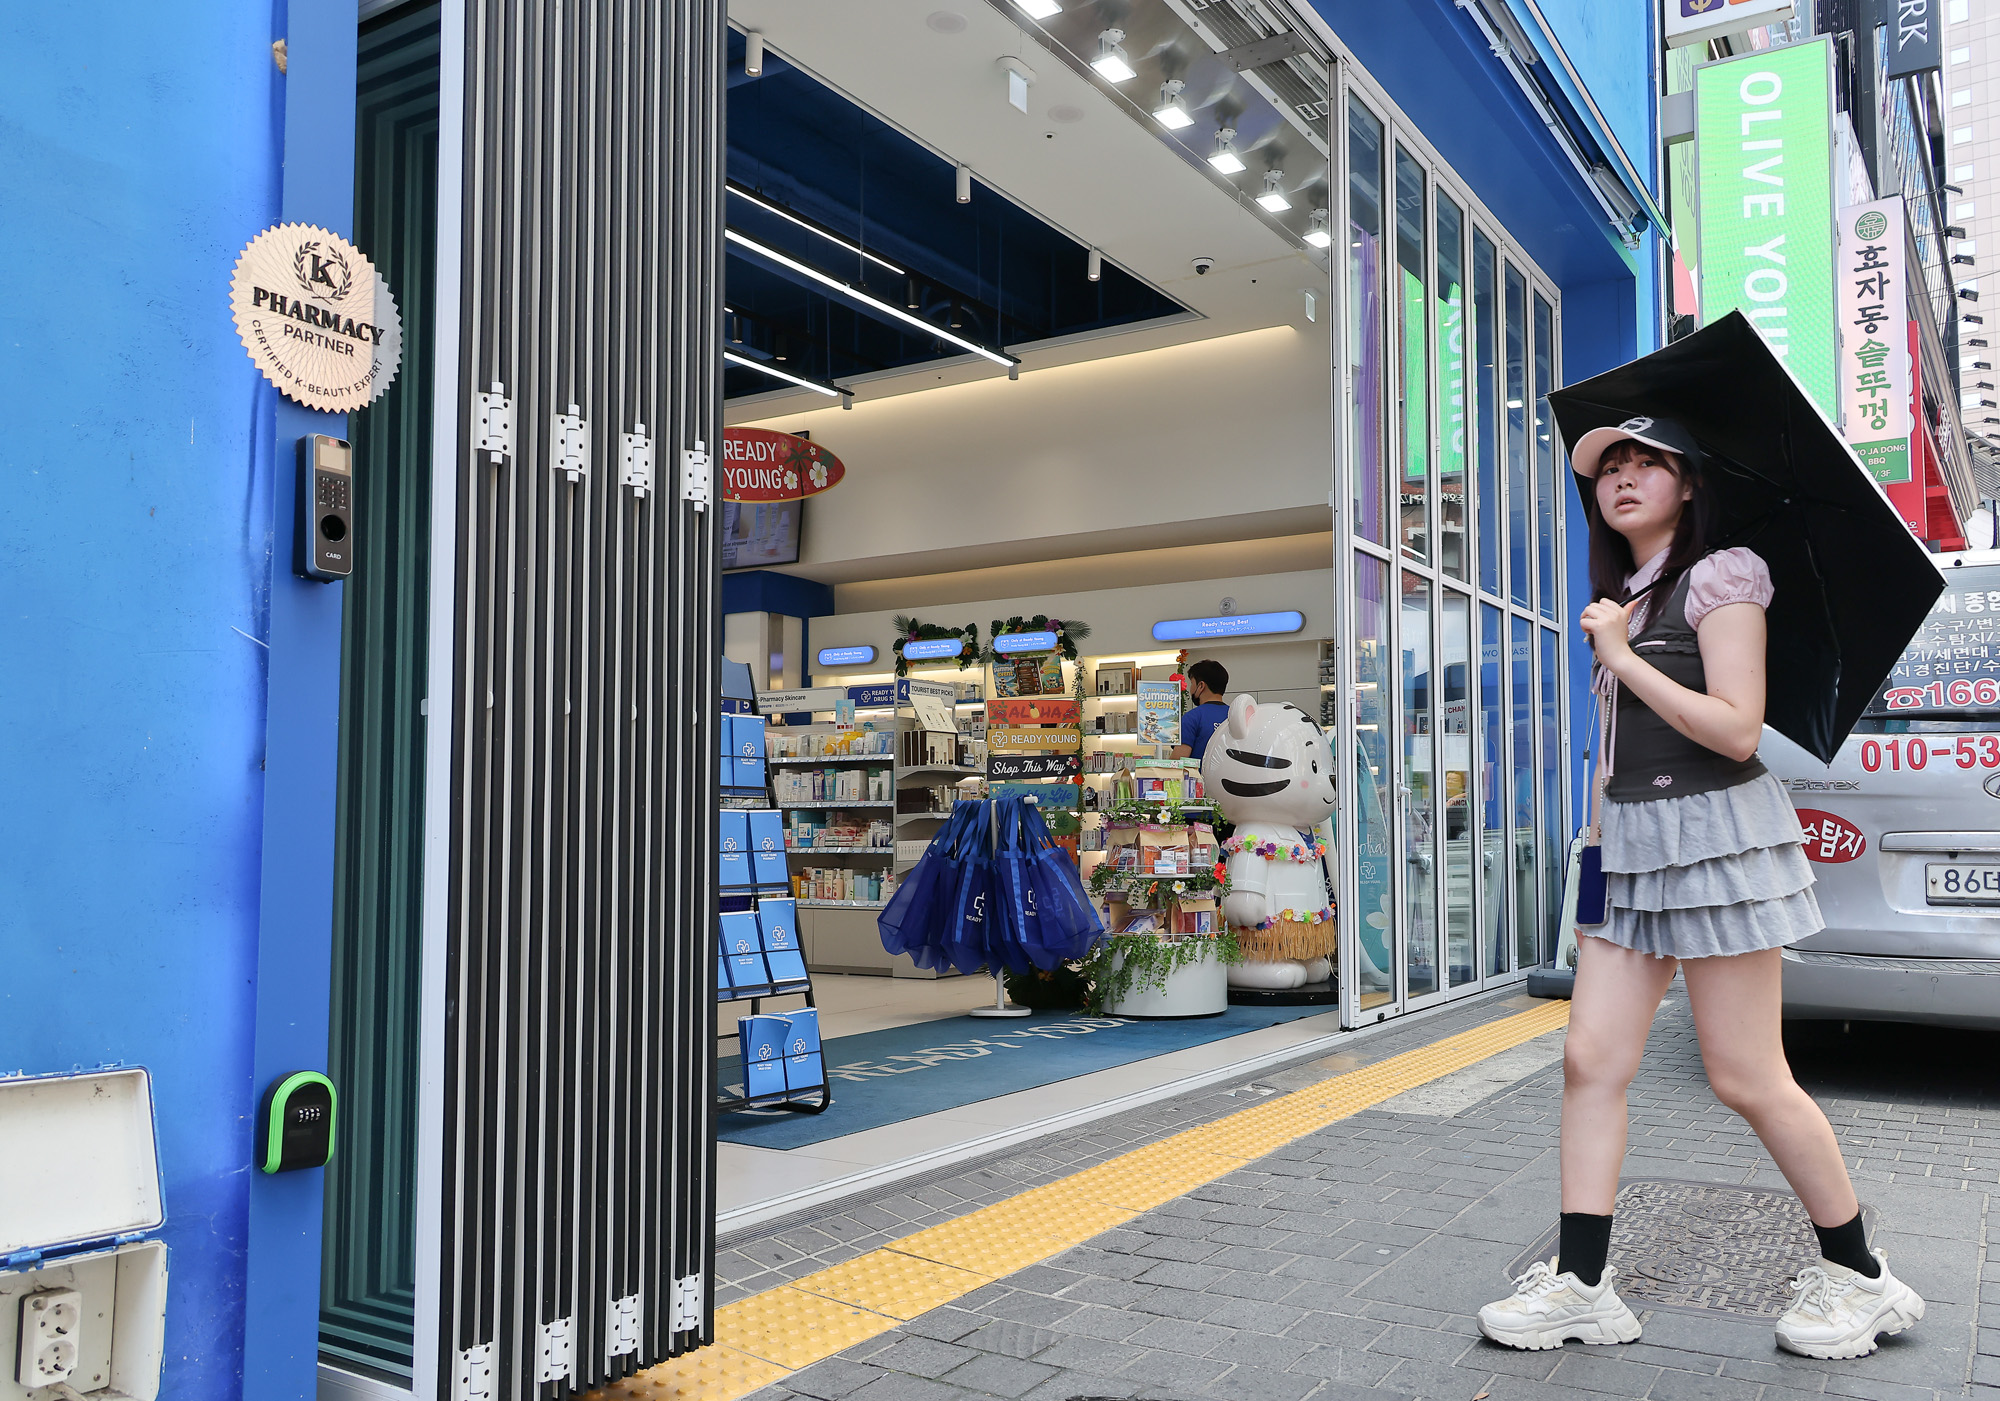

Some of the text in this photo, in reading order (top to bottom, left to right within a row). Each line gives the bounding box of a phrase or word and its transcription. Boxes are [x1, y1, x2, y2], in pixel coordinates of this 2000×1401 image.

[1739, 71, 1789, 357] OLIVE YOU
[310, 254, 337, 289] K
[252, 286, 385, 347] PHARMACY
[284, 324, 354, 357] PARTNER
[252, 319, 383, 397] CERTIFIED K-BEAUTY EXPERT
[724, 439, 777, 462] READY
[1868, 447, 1879, 455] JA
[1880, 444, 1906, 454] DONG
[1868, 457, 1886, 465] BBQ
[724, 467, 782, 490] YOUNG
[1880, 469, 1891, 478] 3F
[325, 552, 342, 560] CARD
[901, 684, 907, 696] 4
[911, 686, 930, 694] TOURIST
[941, 689, 954, 697] PICKS
[1139, 692, 1179, 702] summer
[1926, 679, 2000, 707] 166
[743, 700, 750, 709] 5
[1145, 701, 1174, 710] event
[1011, 734, 1077, 744] READY YOUNG
[992, 759, 1066, 776] Shop This Way
[1792, 777, 1860, 791] Starex
[1048, 787, 1073, 803] Life
[1358, 833, 1387, 856] oha!
[965, 914, 983, 923] READY
